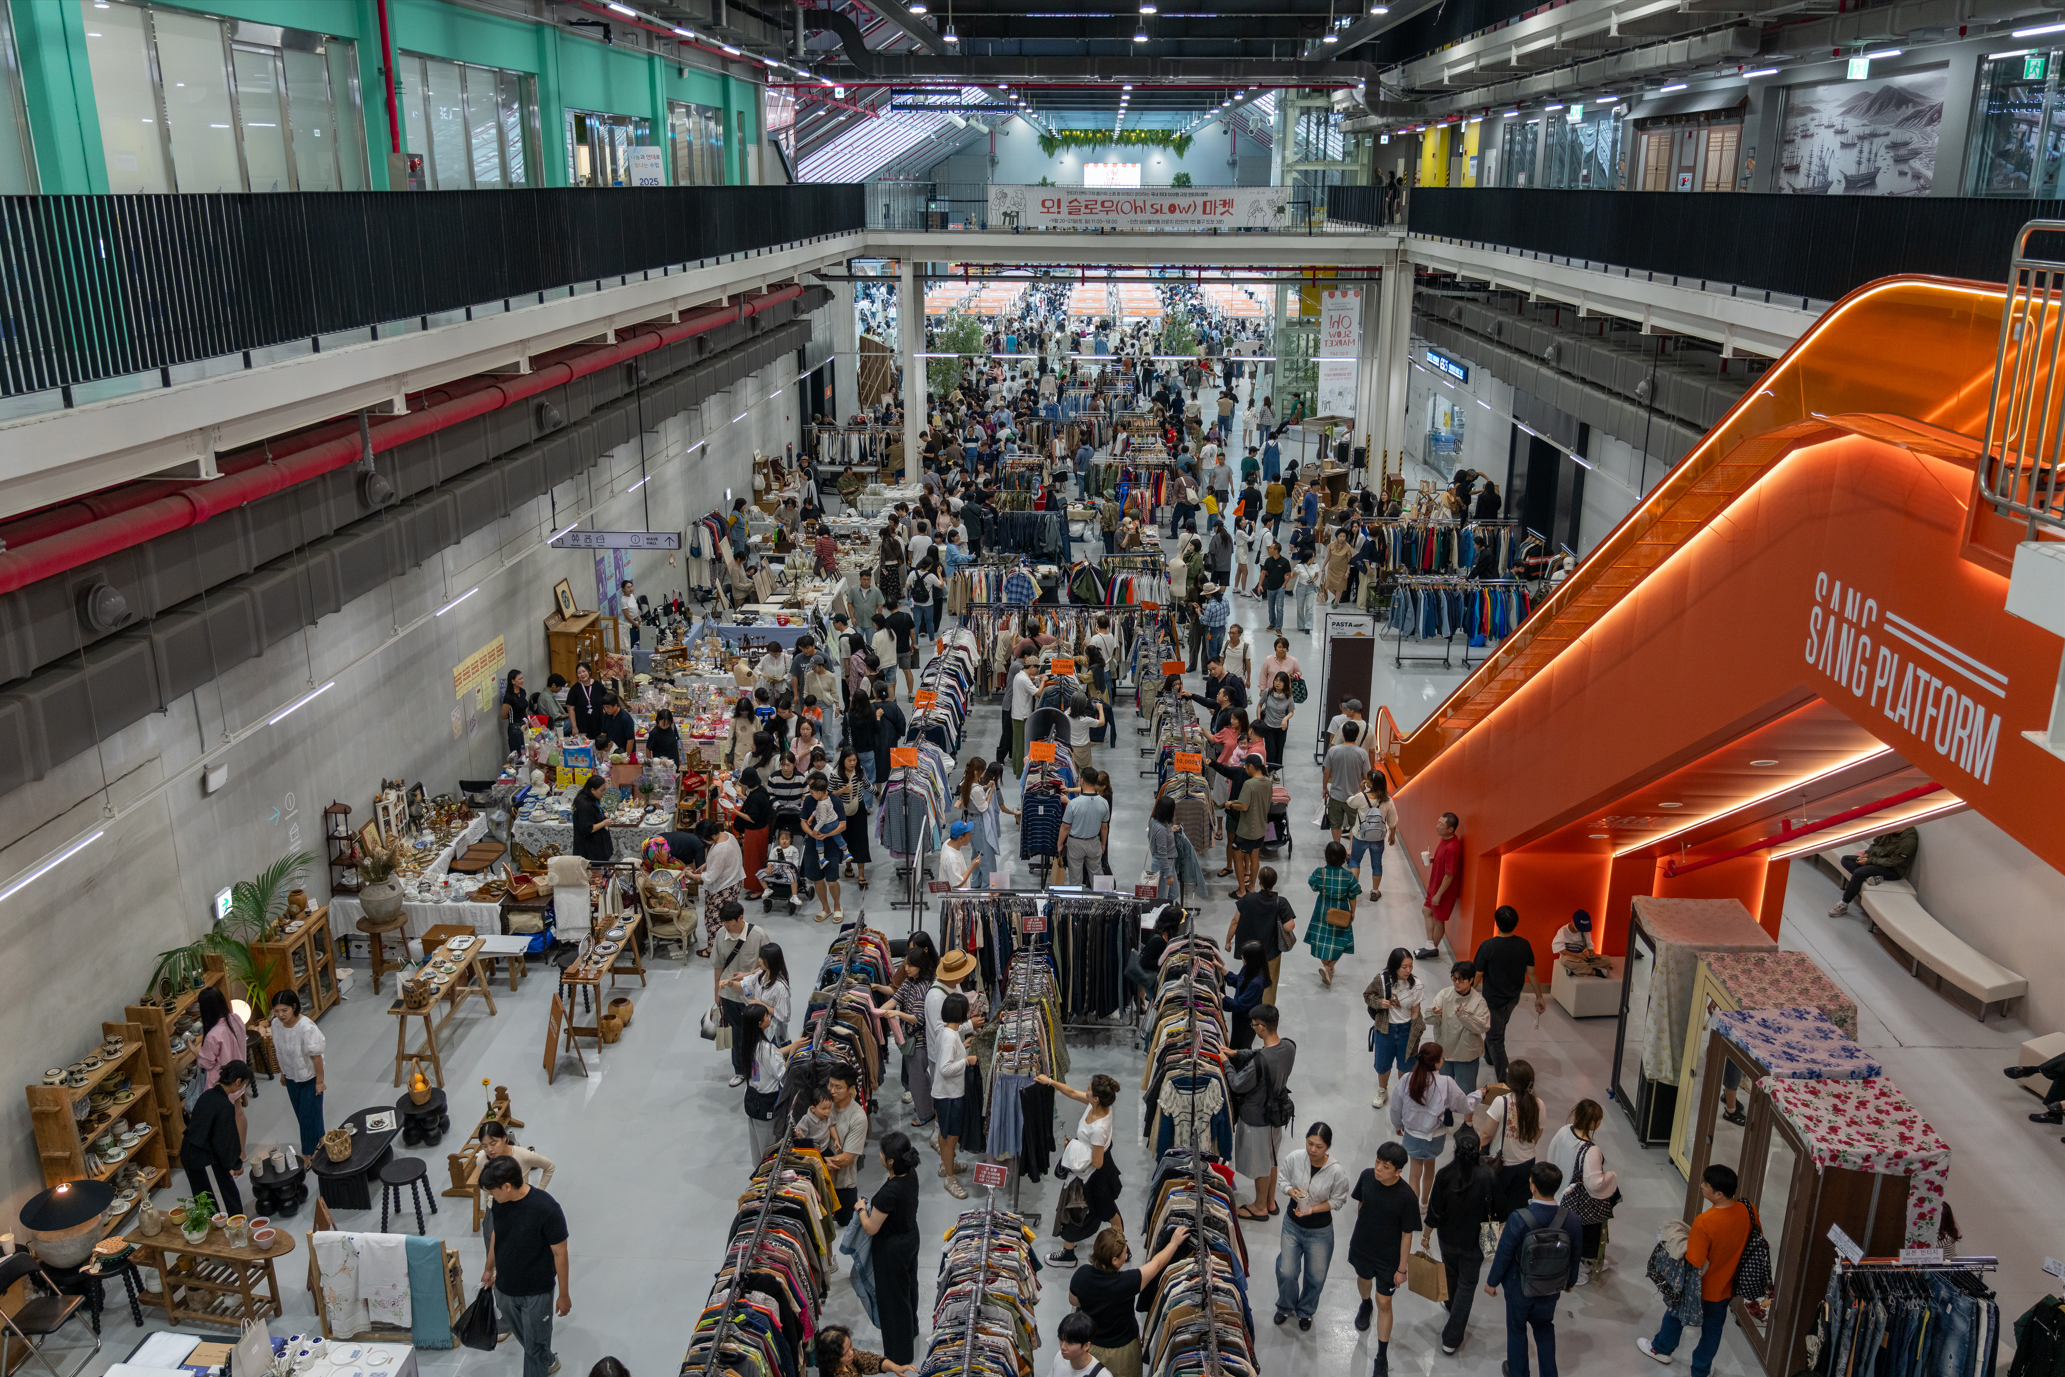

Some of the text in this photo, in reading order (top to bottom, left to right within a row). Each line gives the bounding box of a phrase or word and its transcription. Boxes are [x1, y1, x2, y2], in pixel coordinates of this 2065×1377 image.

[639, 177, 660, 186] 2025
[1040, 198, 1061, 214] 오!
[1150, 199, 1197, 216] SLOW)
[1202, 198, 1234, 216] 마켓
[1804, 604, 2002, 786] SANG PLATFORM
